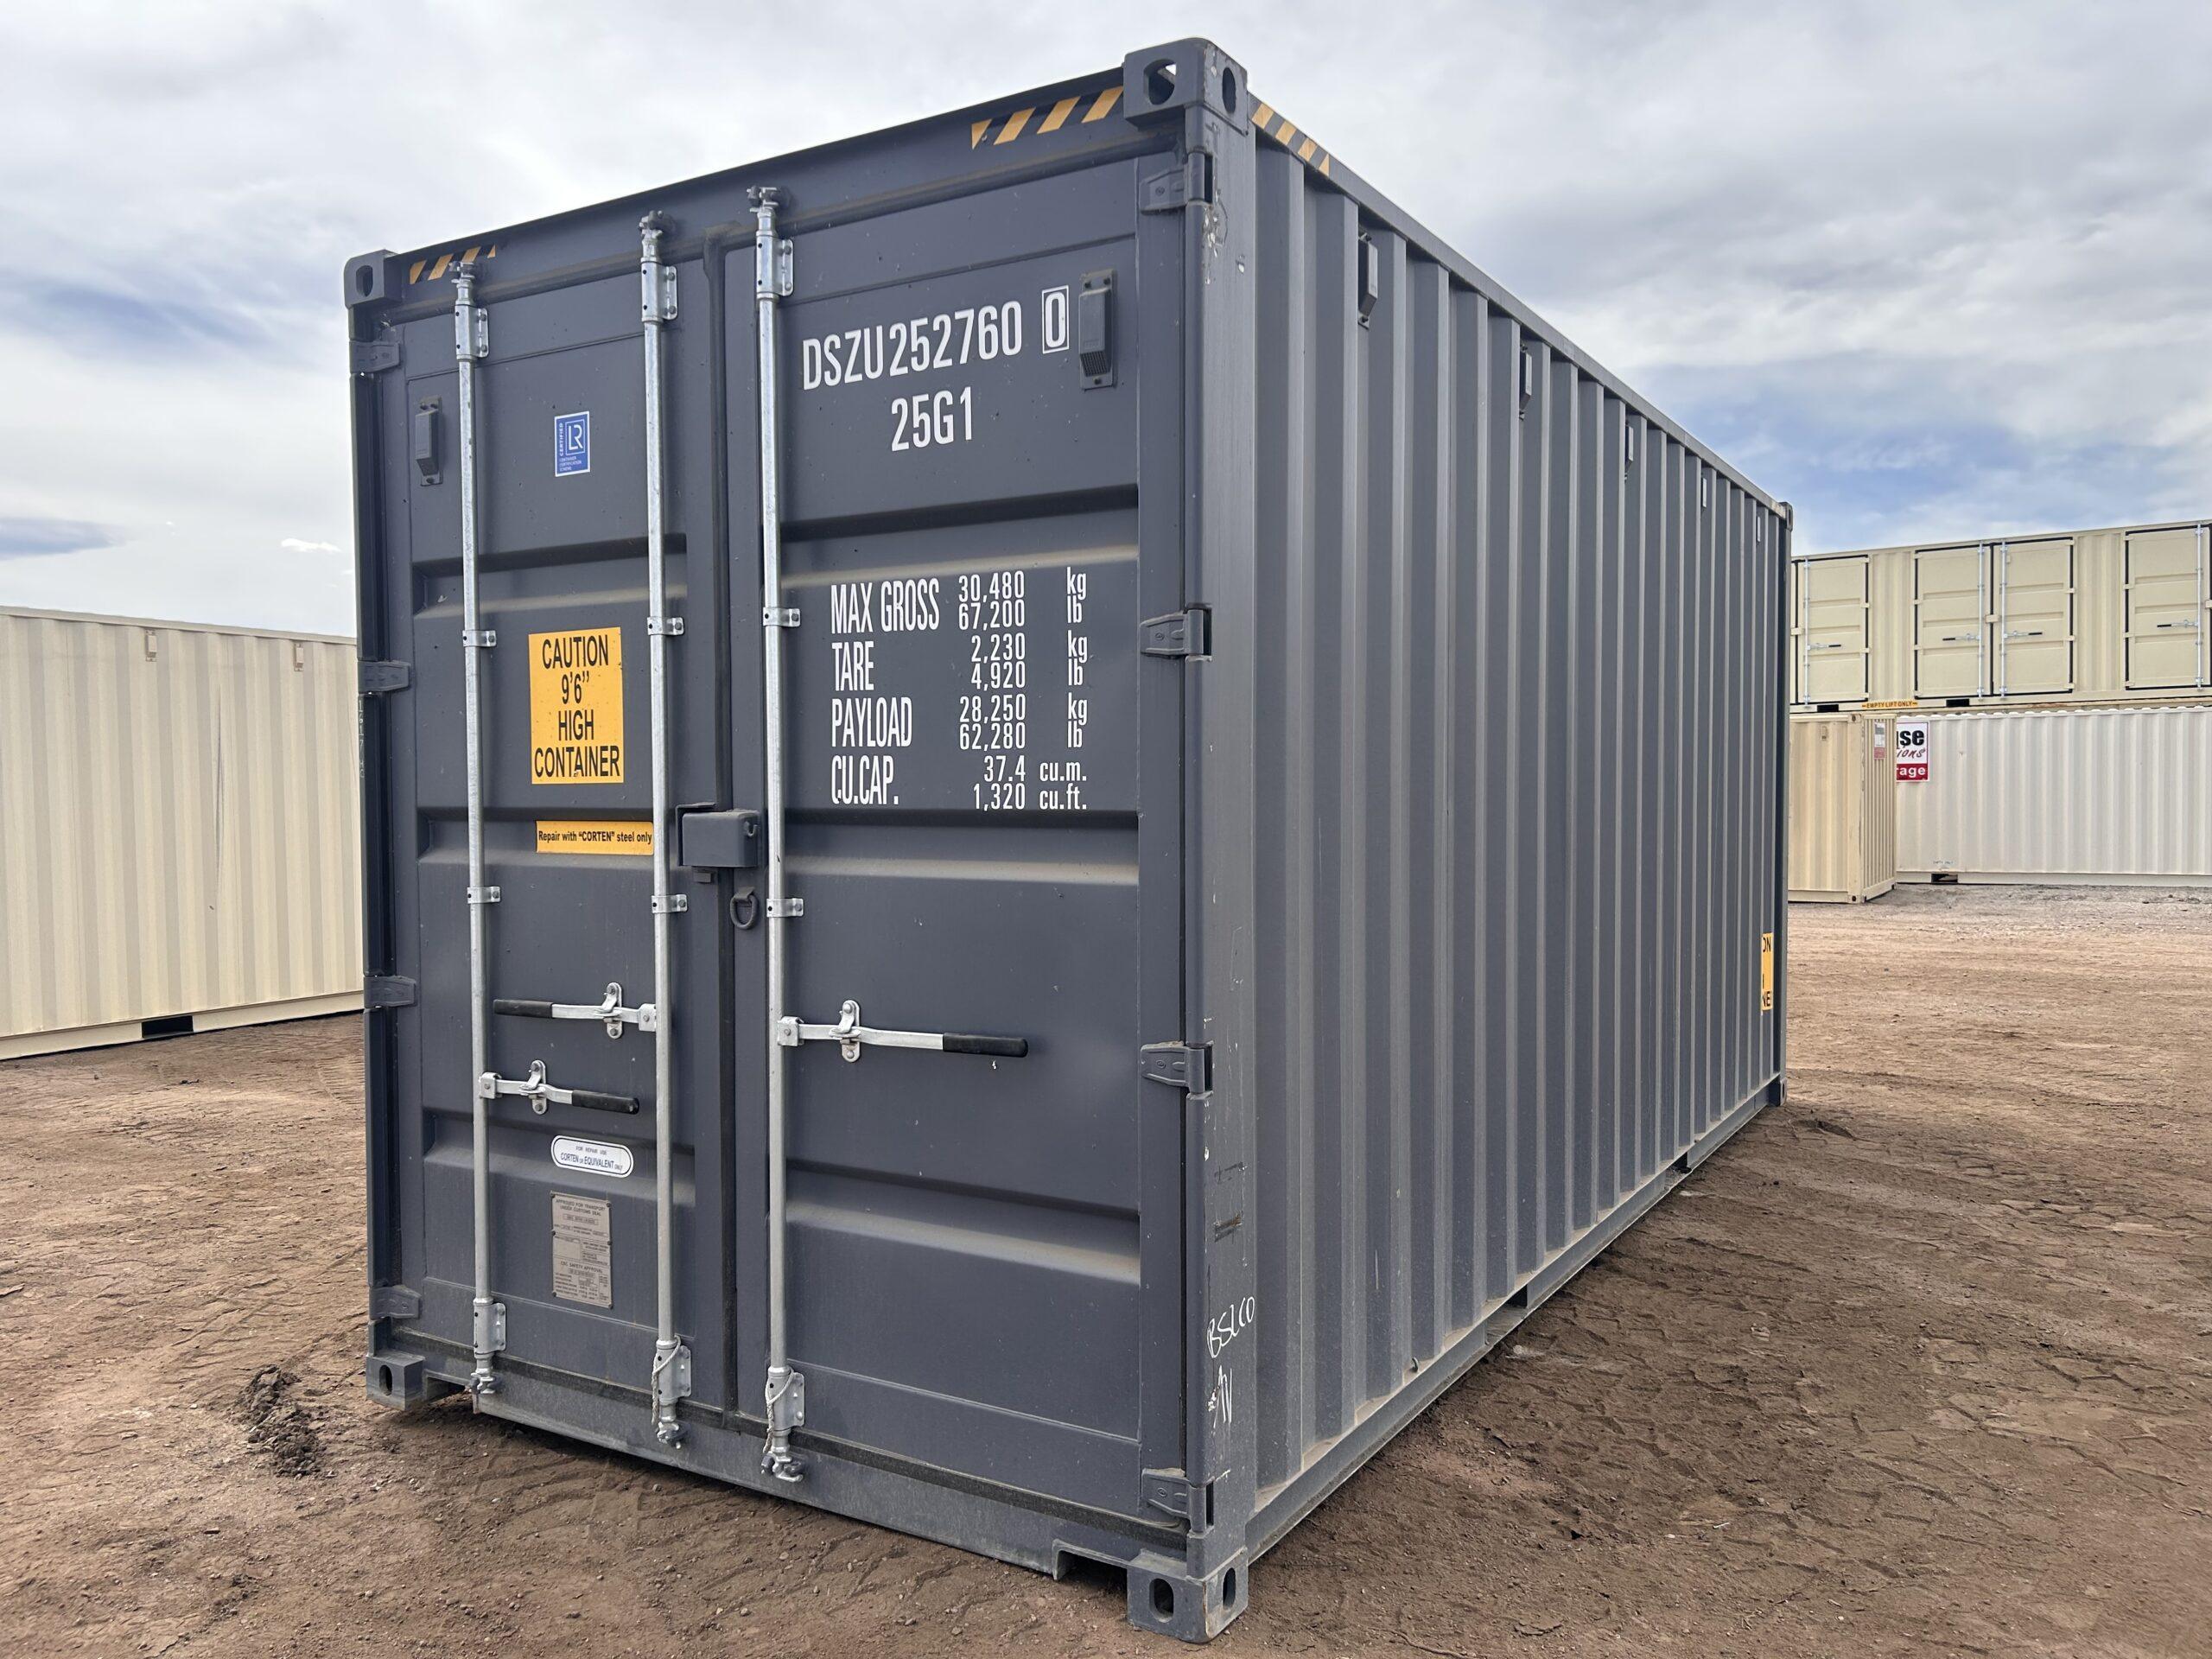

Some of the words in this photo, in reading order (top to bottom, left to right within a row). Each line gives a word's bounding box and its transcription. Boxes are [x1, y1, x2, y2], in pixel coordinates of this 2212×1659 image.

[1045, 291, 1066, 349] 0
[891, 386, 972, 452] 25G1
[568, 424, 583, 450] LR
[830, 582, 874, 634] MAX
[880, 577, 940, 632] GROSS
[958, 570, 1025, 602] 30,480
[1066, 566, 1087, 601] kg
[957, 599, 1025, 631] 67,200
[1066, 595, 1084, 624] lb
[542, 634, 609, 670] CAUTION
[831, 640, 874, 691] TARE
[971, 632, 1026, 664] 2,230
[1067, 629, 1088, 663] kg
[970, 660, 1026, 691] 4,920
[1067, 658, 1084, 686] lb
[558, 709, 594, 741] HIGH
[831, 696, 912, 747] PAYLOAD
[959, 693, 1026, 724] 28,250
[1067, 691, 1087, 726] kg
[959, 722, 1026, 752] 62,280
[1067, 720, 1084, 748] lb
[1897, 730, 1924, 747] se
[534, 745, 620, 778] CONTAINER
[983, 754, 1026, 782] 37.4
[1039, 761, 1087, 782] cu.m.
[1897, 766, 1926, 778] age
[973, 783, 1026, 811] 1,320
[1039, 785, 1087, 810] cu.ft.
[538, 830, 560, 843] Repair
[562, 830, 577, 842] with
[617, 831, 635, 842] steel
[637, 831, 652, 845] only
[560, 1152, 579, 1163] CORTEN
[584, 1156, 614, 1169] EQUIVALENT
